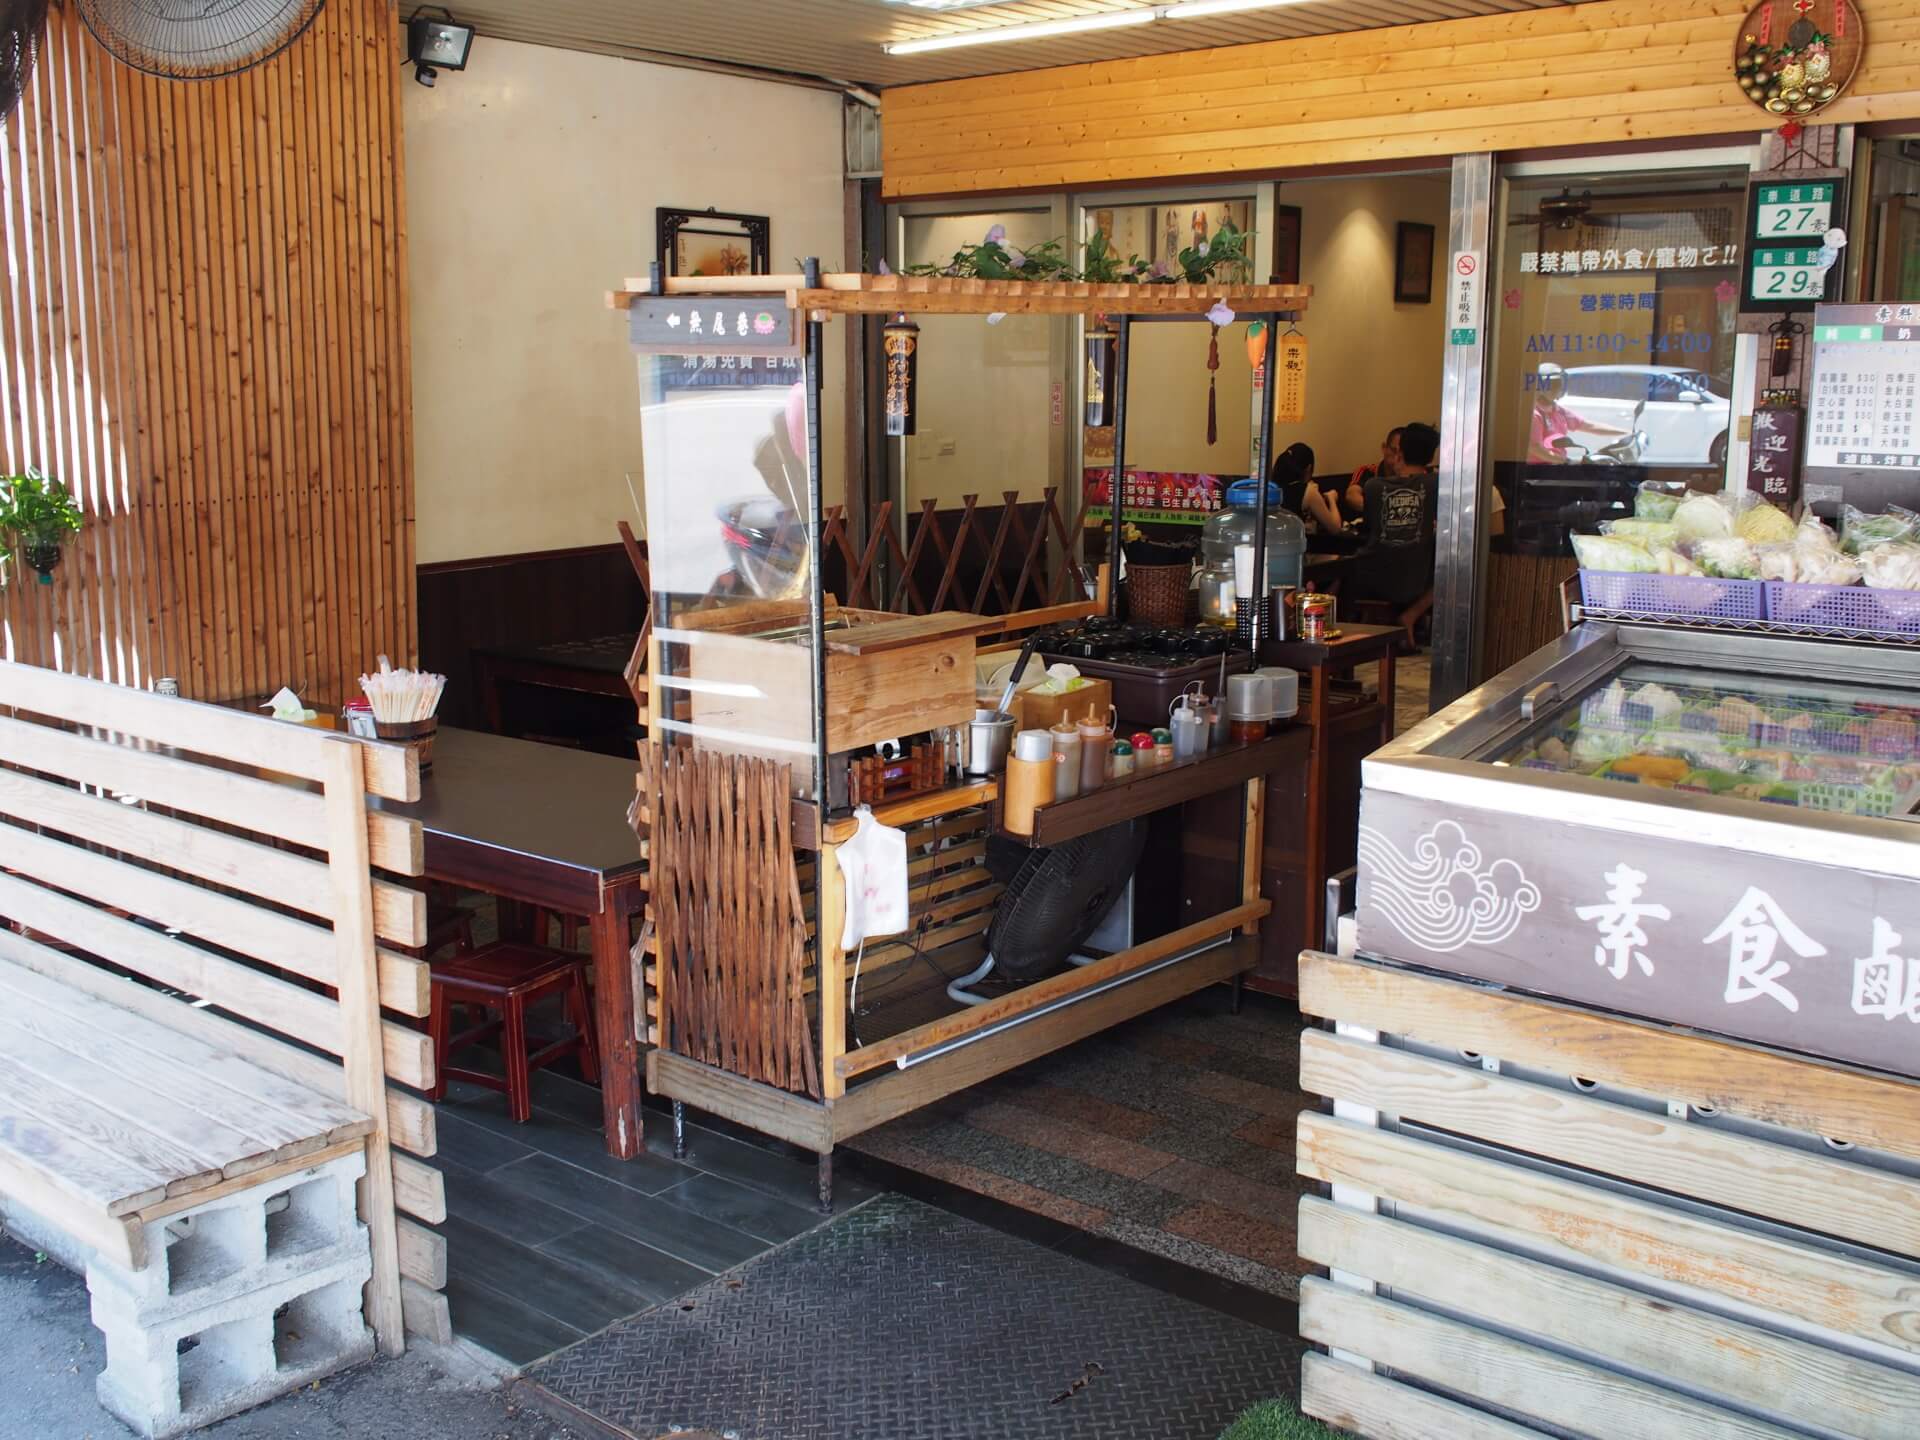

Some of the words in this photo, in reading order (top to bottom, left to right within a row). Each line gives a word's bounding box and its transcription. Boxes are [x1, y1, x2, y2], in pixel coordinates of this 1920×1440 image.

[1772, 207, 1815, 232] 27
[1766, 271, 1809, 294] 29
[1579, 292, 1657, 312] 營業時間
[1525, 335, 1555, 353] AM
[1523, 373, 1552, 392] PM
[1752, 410, 1789, 495] 歡迎光臨
